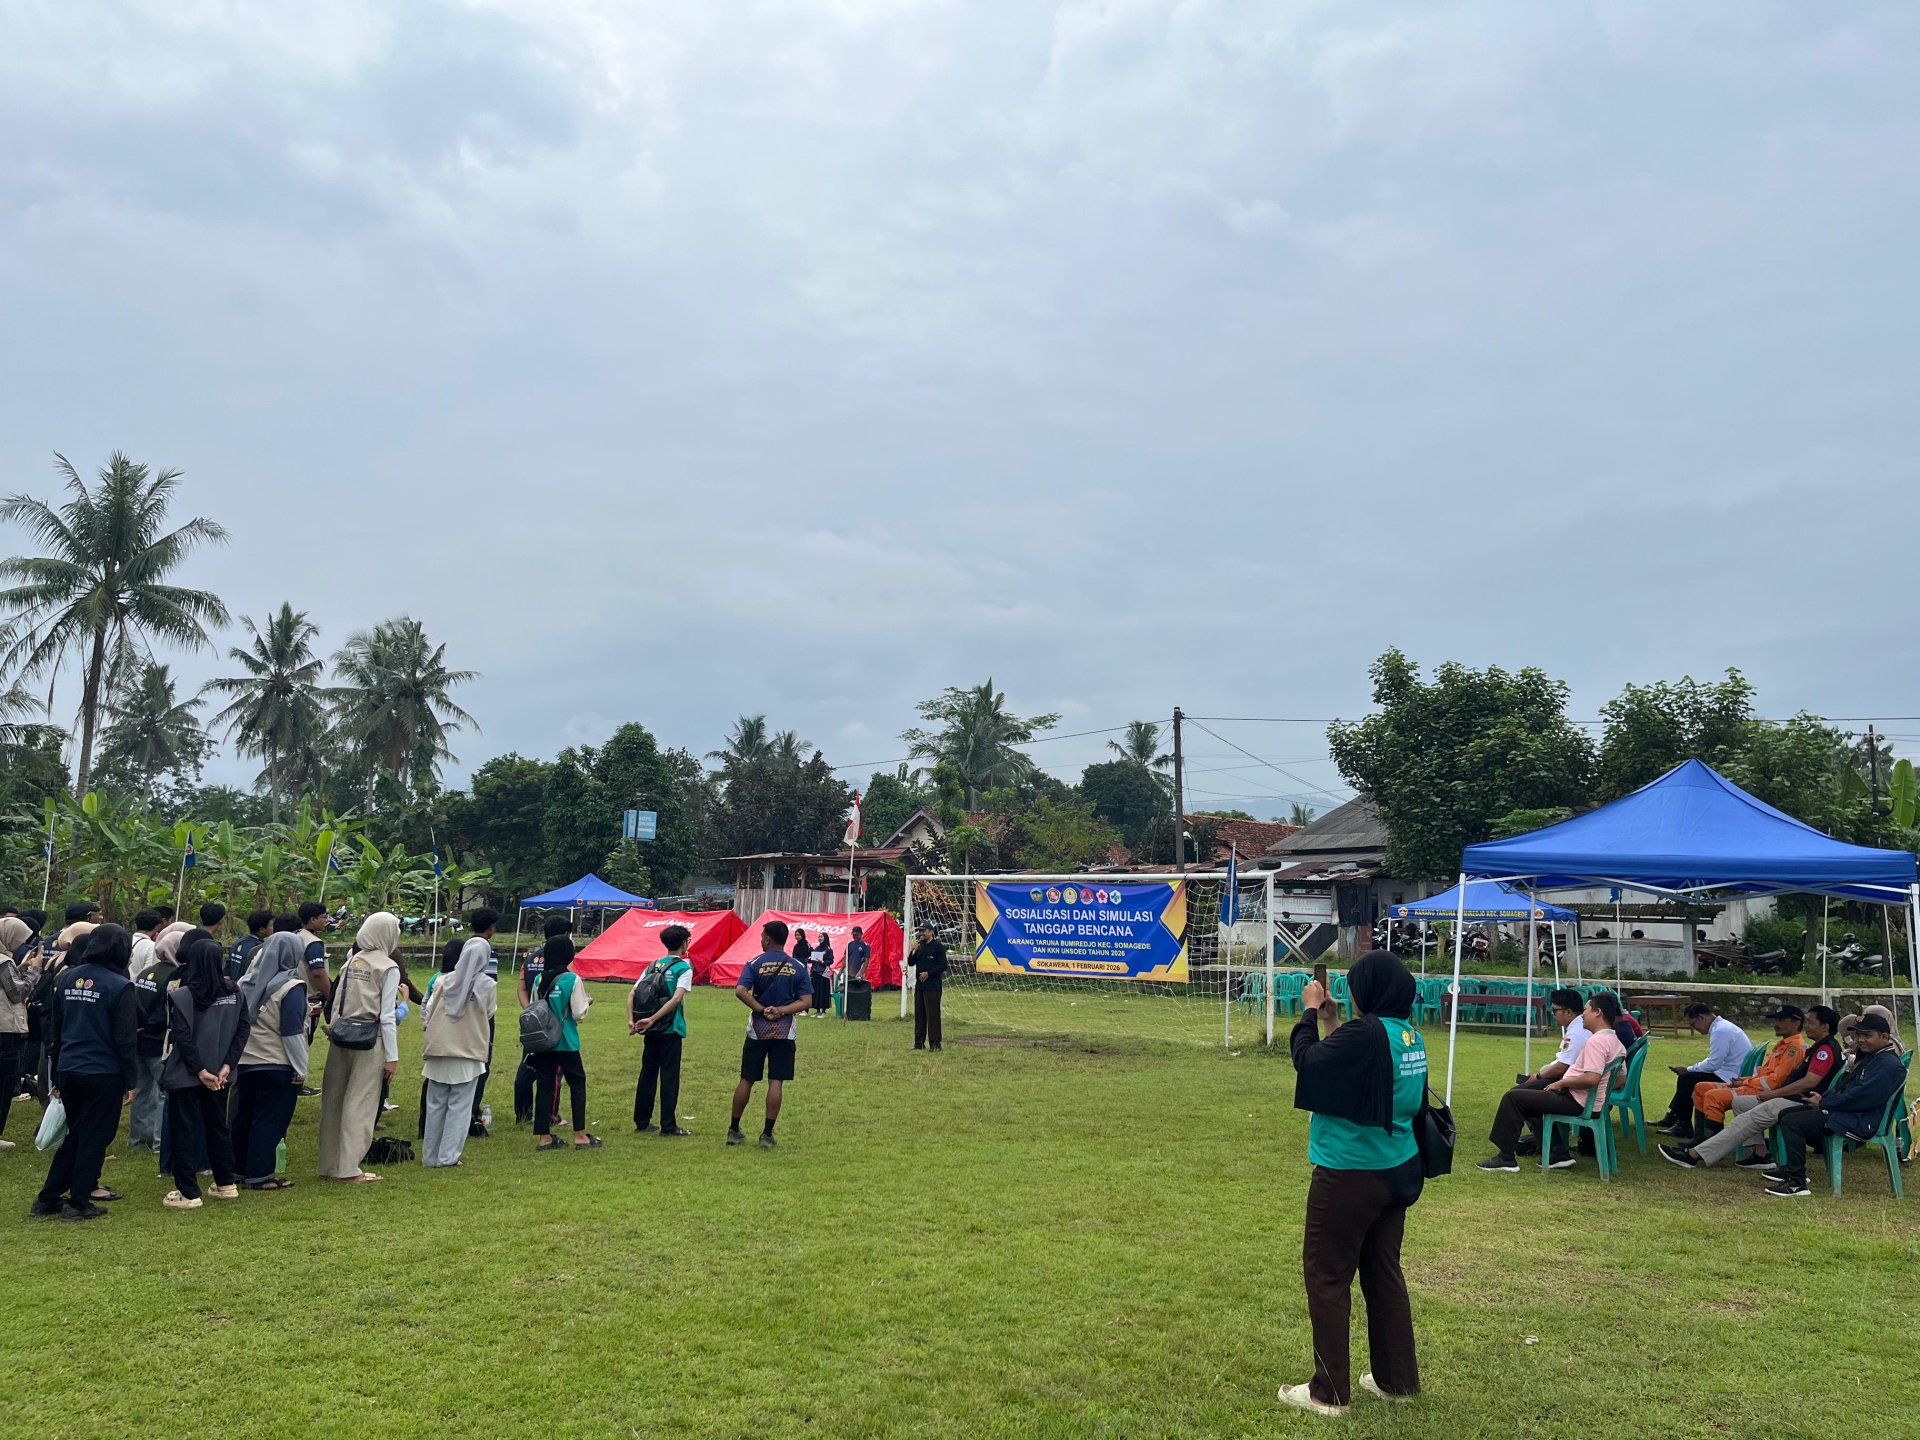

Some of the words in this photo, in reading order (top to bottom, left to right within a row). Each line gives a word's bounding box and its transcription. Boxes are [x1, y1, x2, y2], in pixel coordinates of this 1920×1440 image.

[1005, 908, 1070, 921] SOSIALISASI
[1073, 909, 1096, 921] DAN
[1099, 910, 1154, 922] SIMULASI
[1023, 922, 1075, 935] TANGGAP
[1078, 924, 1134, 937] BENCANA
[1008, 938, 1034, 946] KARANG
[1035, 939, 1060, 947] TARUNA
[1060, 940, 1097, 948] BUMIREDJO
[1114, 942, 1152, 950] SOMAGEDE
[1088, 949, 1110, 957] TAHUN
[1037, 961, 1071, 970] SOKAWERA,
[1106, 963, 1121, 971] 2026
